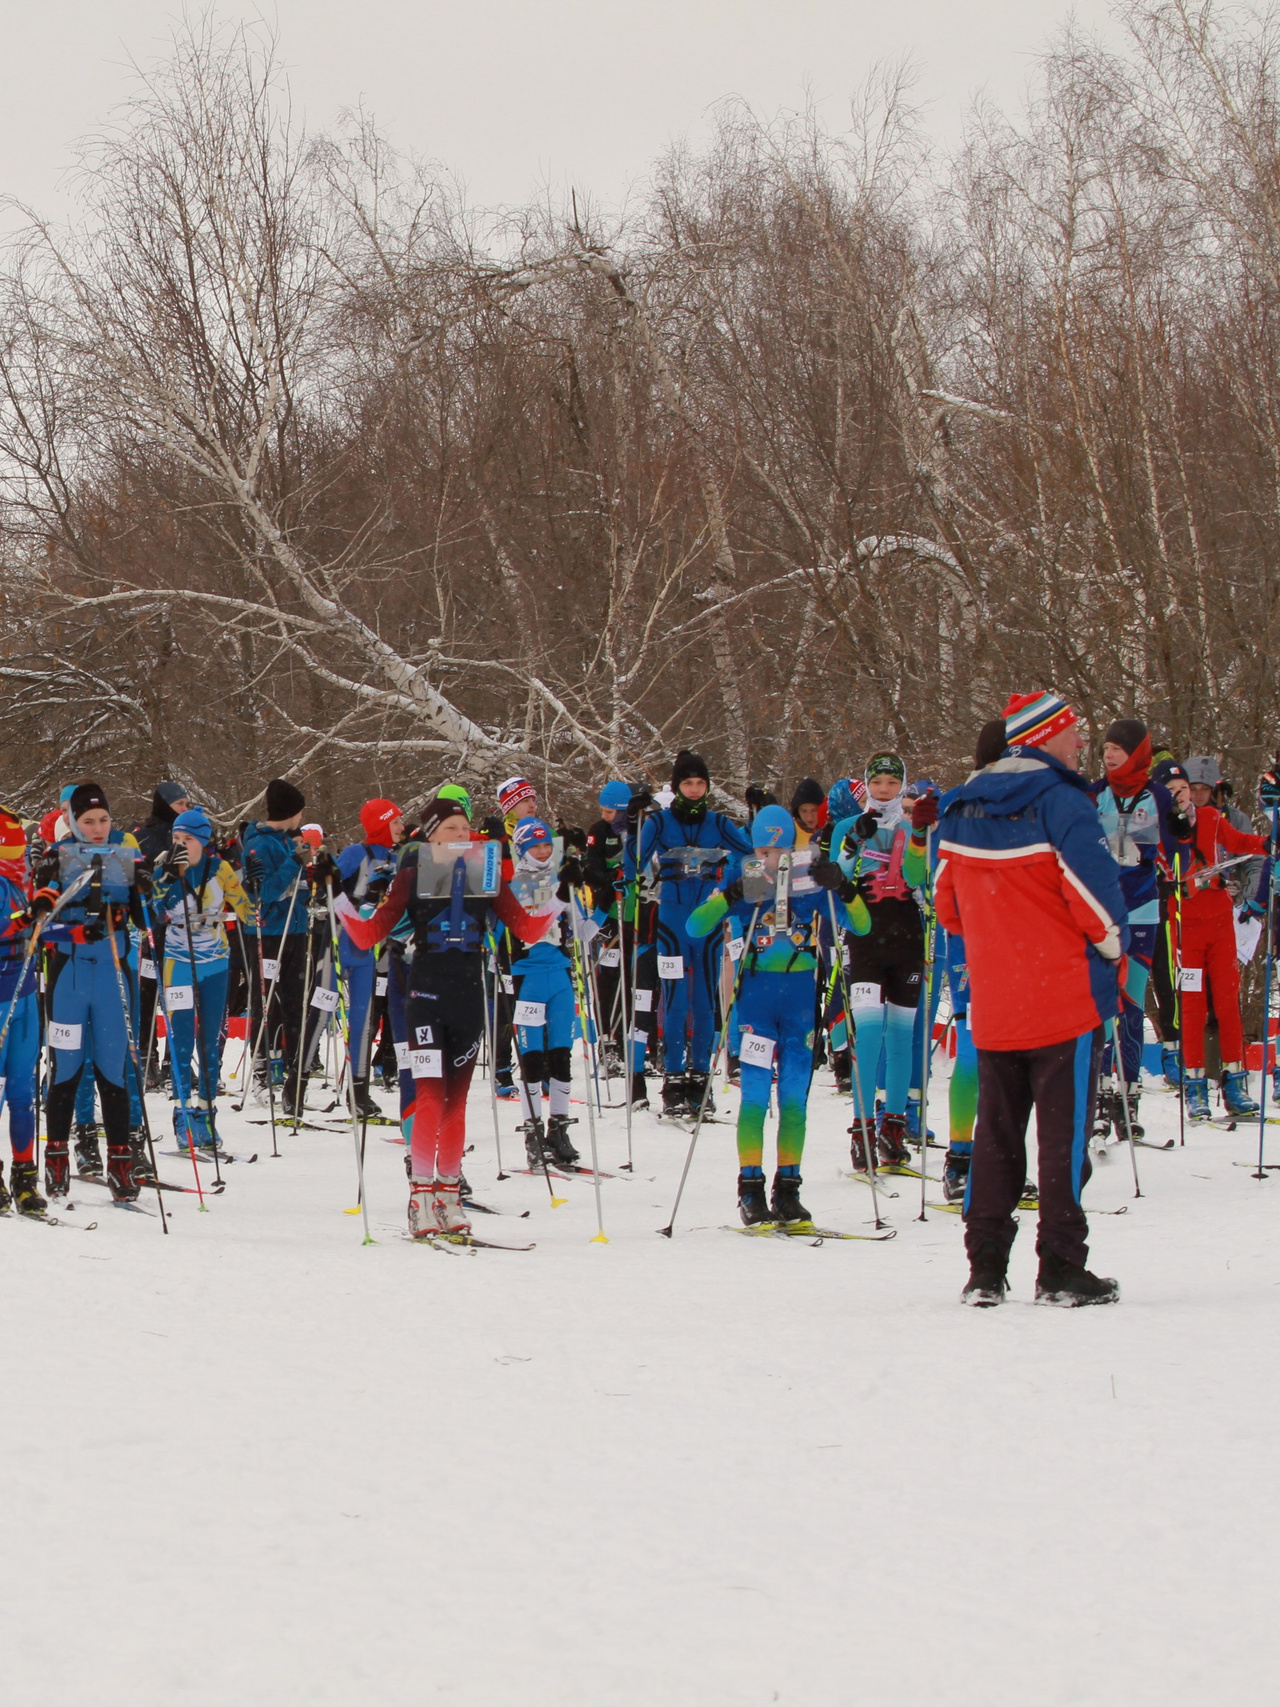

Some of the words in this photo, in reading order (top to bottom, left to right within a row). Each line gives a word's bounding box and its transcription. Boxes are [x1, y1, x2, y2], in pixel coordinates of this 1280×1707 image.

[485, 847, 494, 888] MAGNETO
[855, 987, 871, 995] 714
[321, 992, 333, 1001] 744
[525, 1006, 538, 1014] 724
[55, 1028, 70, 1037] 716
[749, 1042, 766, 1053] 705
[414, 1055, 430, 1064] 706
